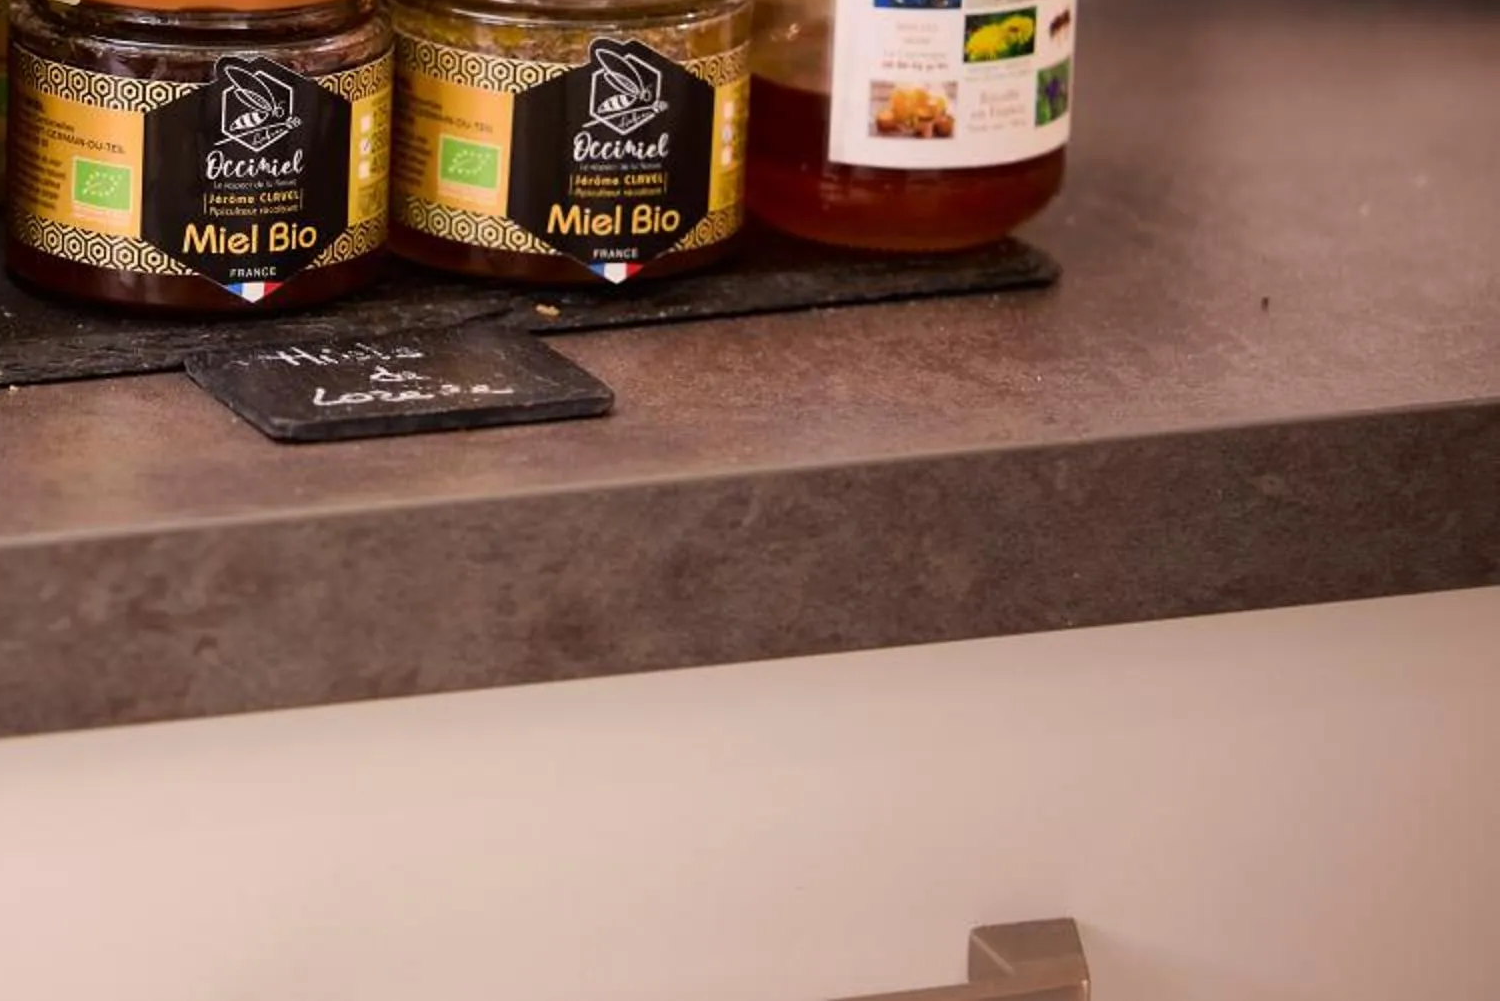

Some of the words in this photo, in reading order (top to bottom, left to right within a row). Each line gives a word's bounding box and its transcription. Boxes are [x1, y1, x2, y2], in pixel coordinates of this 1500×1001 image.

[547, 204, 622, 237] Miel
[631, 204, 681, 236] Bio
[182, 222, 259, 255] Miel
[269, 222, 318, 253] Bio
[592, 248, 639, 259] FRANCE
[229, 266, 277, 279] FRANCE
